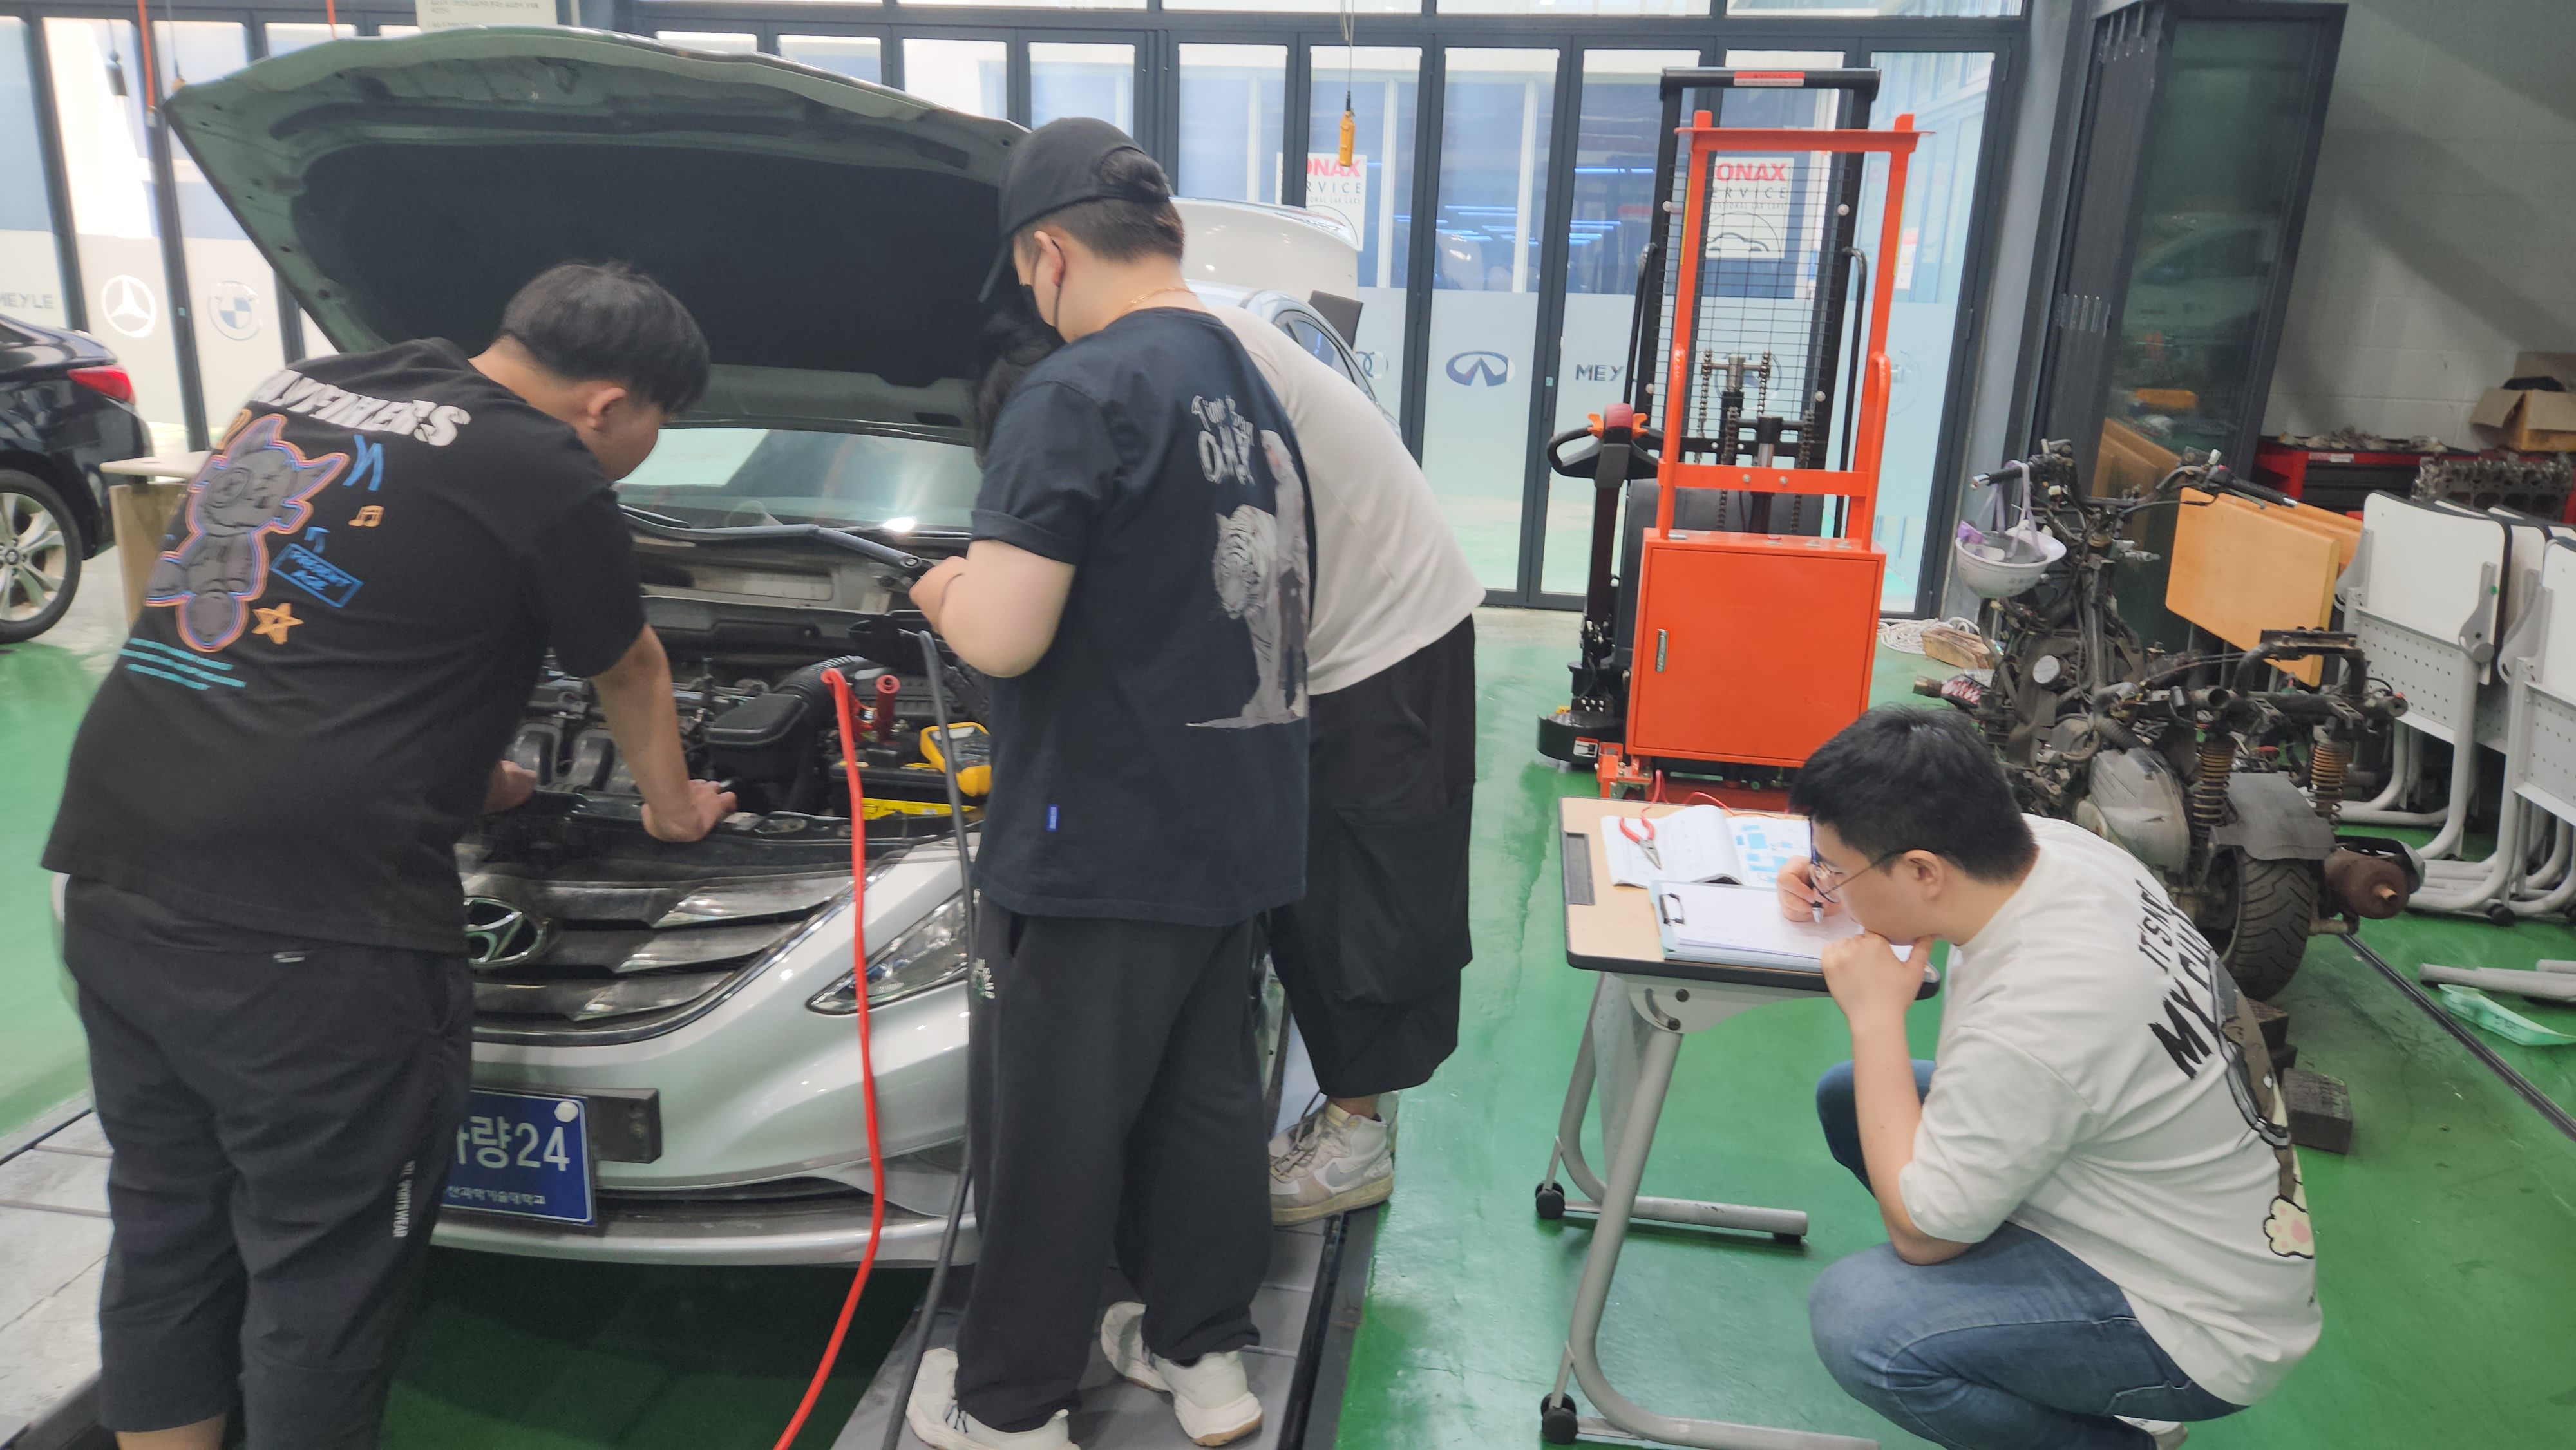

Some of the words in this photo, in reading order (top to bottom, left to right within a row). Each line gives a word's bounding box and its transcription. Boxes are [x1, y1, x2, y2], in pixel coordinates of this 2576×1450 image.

[1307, 158, 1361, 178] NAX
[1716, 162, 1787, 182] ONAX
[1306, 180, 1361, 194] RVICE
[1712, 187, 1786, 199] ERVICE
[1575, 364, 1625, 381] MEY
[2147, 975, 2222, 1080] MY
